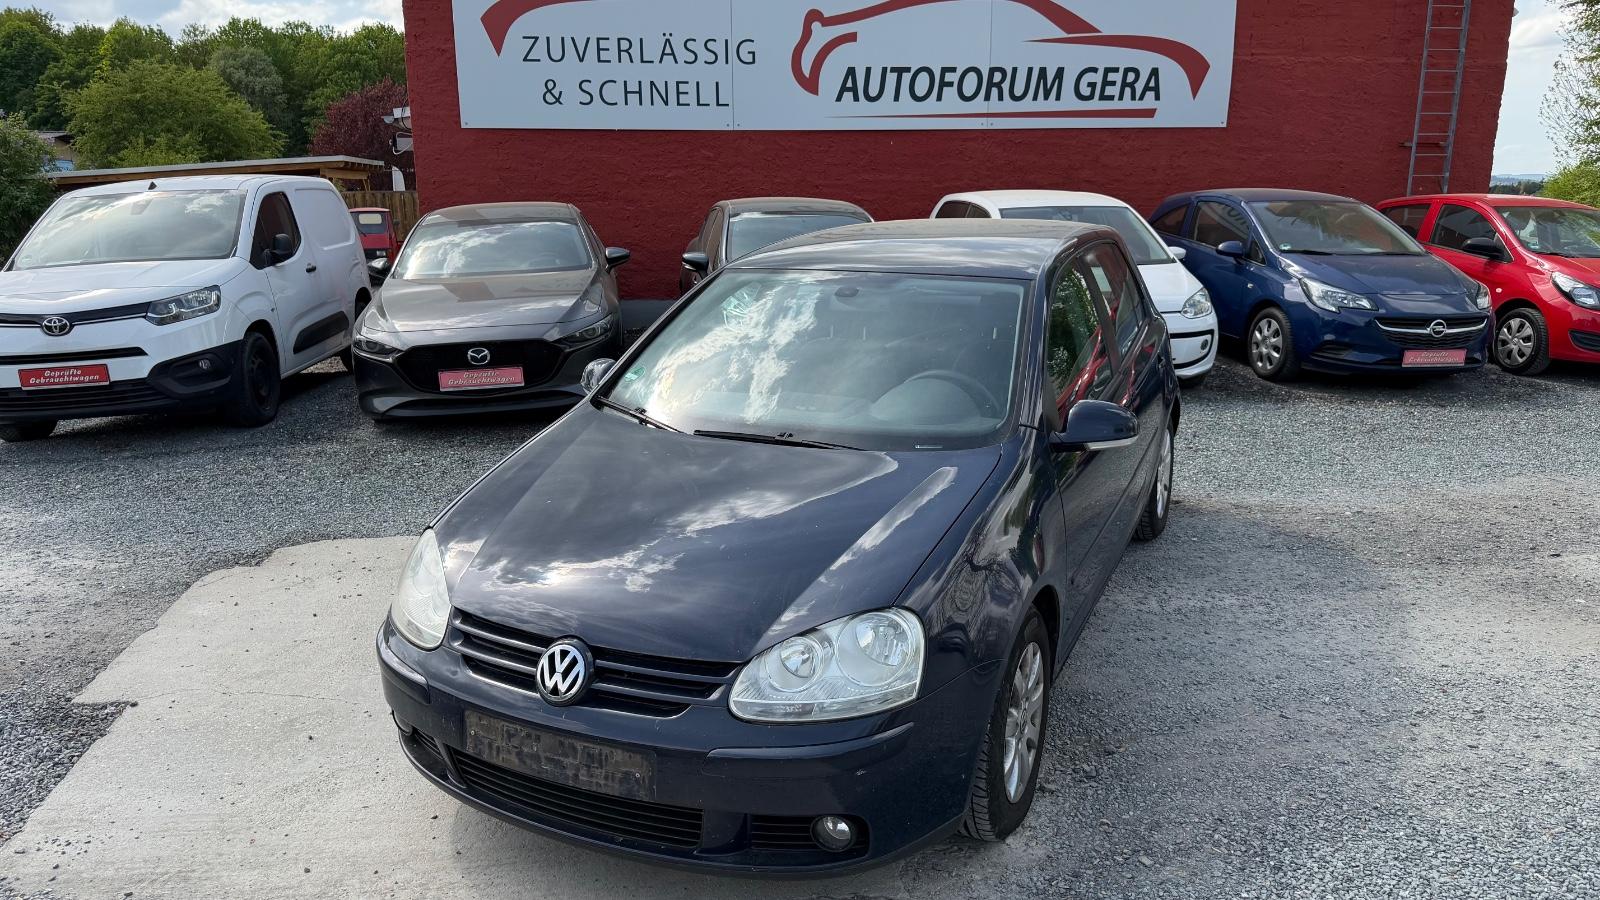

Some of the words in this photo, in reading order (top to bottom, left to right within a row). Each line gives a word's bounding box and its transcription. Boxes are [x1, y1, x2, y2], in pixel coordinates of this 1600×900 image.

[522, 32, 757, 65] ZUVERLÄSSIG
[542, 78, 564, 106] &
[578, 79, 730, 107] SCHNELL
[835, 66, 1065, 103] AUTOFORUM
[1073, 66, 1161, 102] GERA
[29, 375, 99, 384] Gebrauchtwagen
[44, 368, 82, 378] Geprüfte
